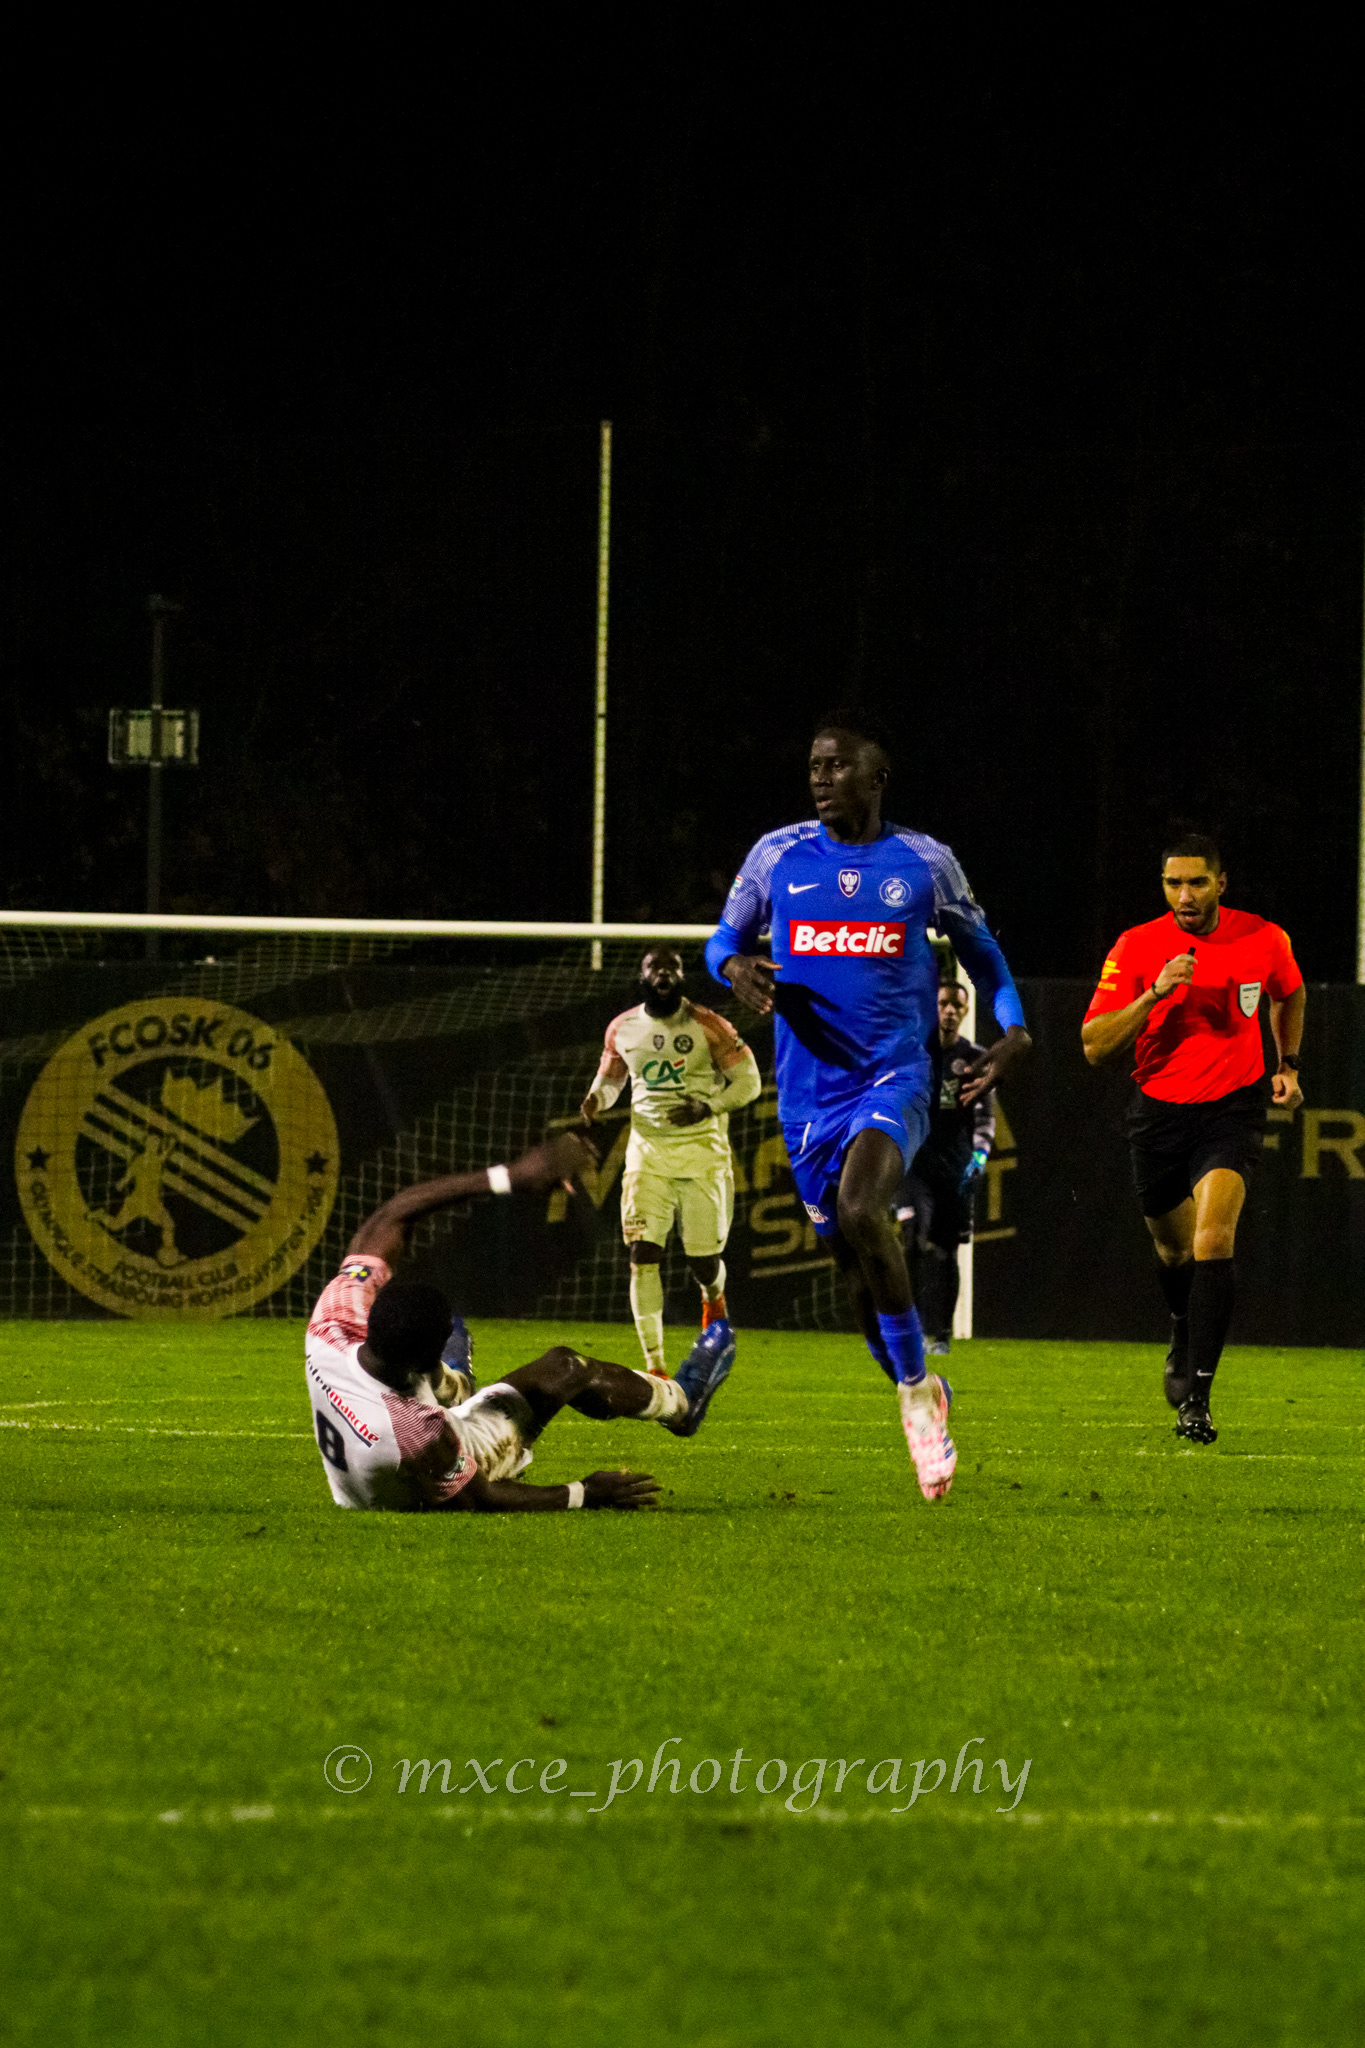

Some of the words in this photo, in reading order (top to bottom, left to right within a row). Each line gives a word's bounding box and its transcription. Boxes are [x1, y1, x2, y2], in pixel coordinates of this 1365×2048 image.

[793, 925, 903, 954] Betclic
[87, 1014, 223, 1067] FCOSK
[225, 1028, 272, 1070] 06
